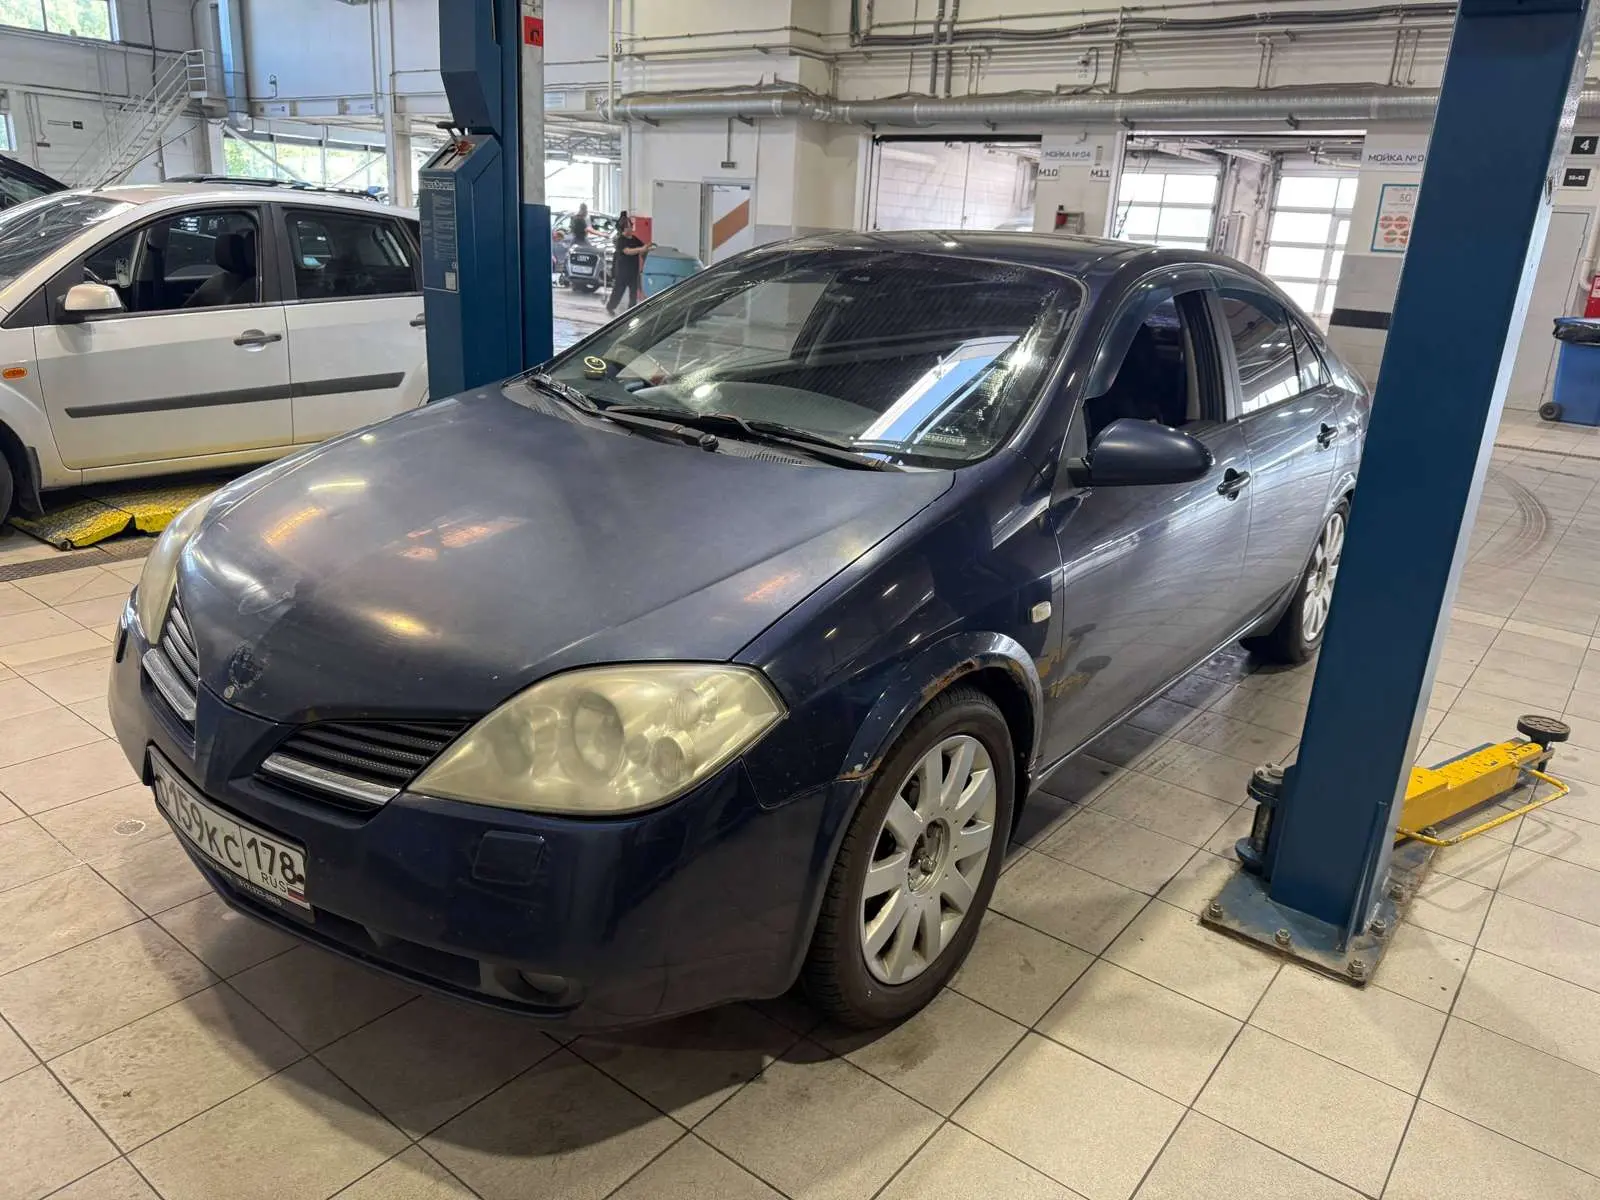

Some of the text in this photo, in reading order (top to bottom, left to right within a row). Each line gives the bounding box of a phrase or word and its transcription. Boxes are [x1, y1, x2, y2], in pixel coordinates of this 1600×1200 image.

[1580, 139, 1590, 150] 4
[1368, 152, 1403, 161] МОЙКА
[261, 872, 288, 893] RUS
